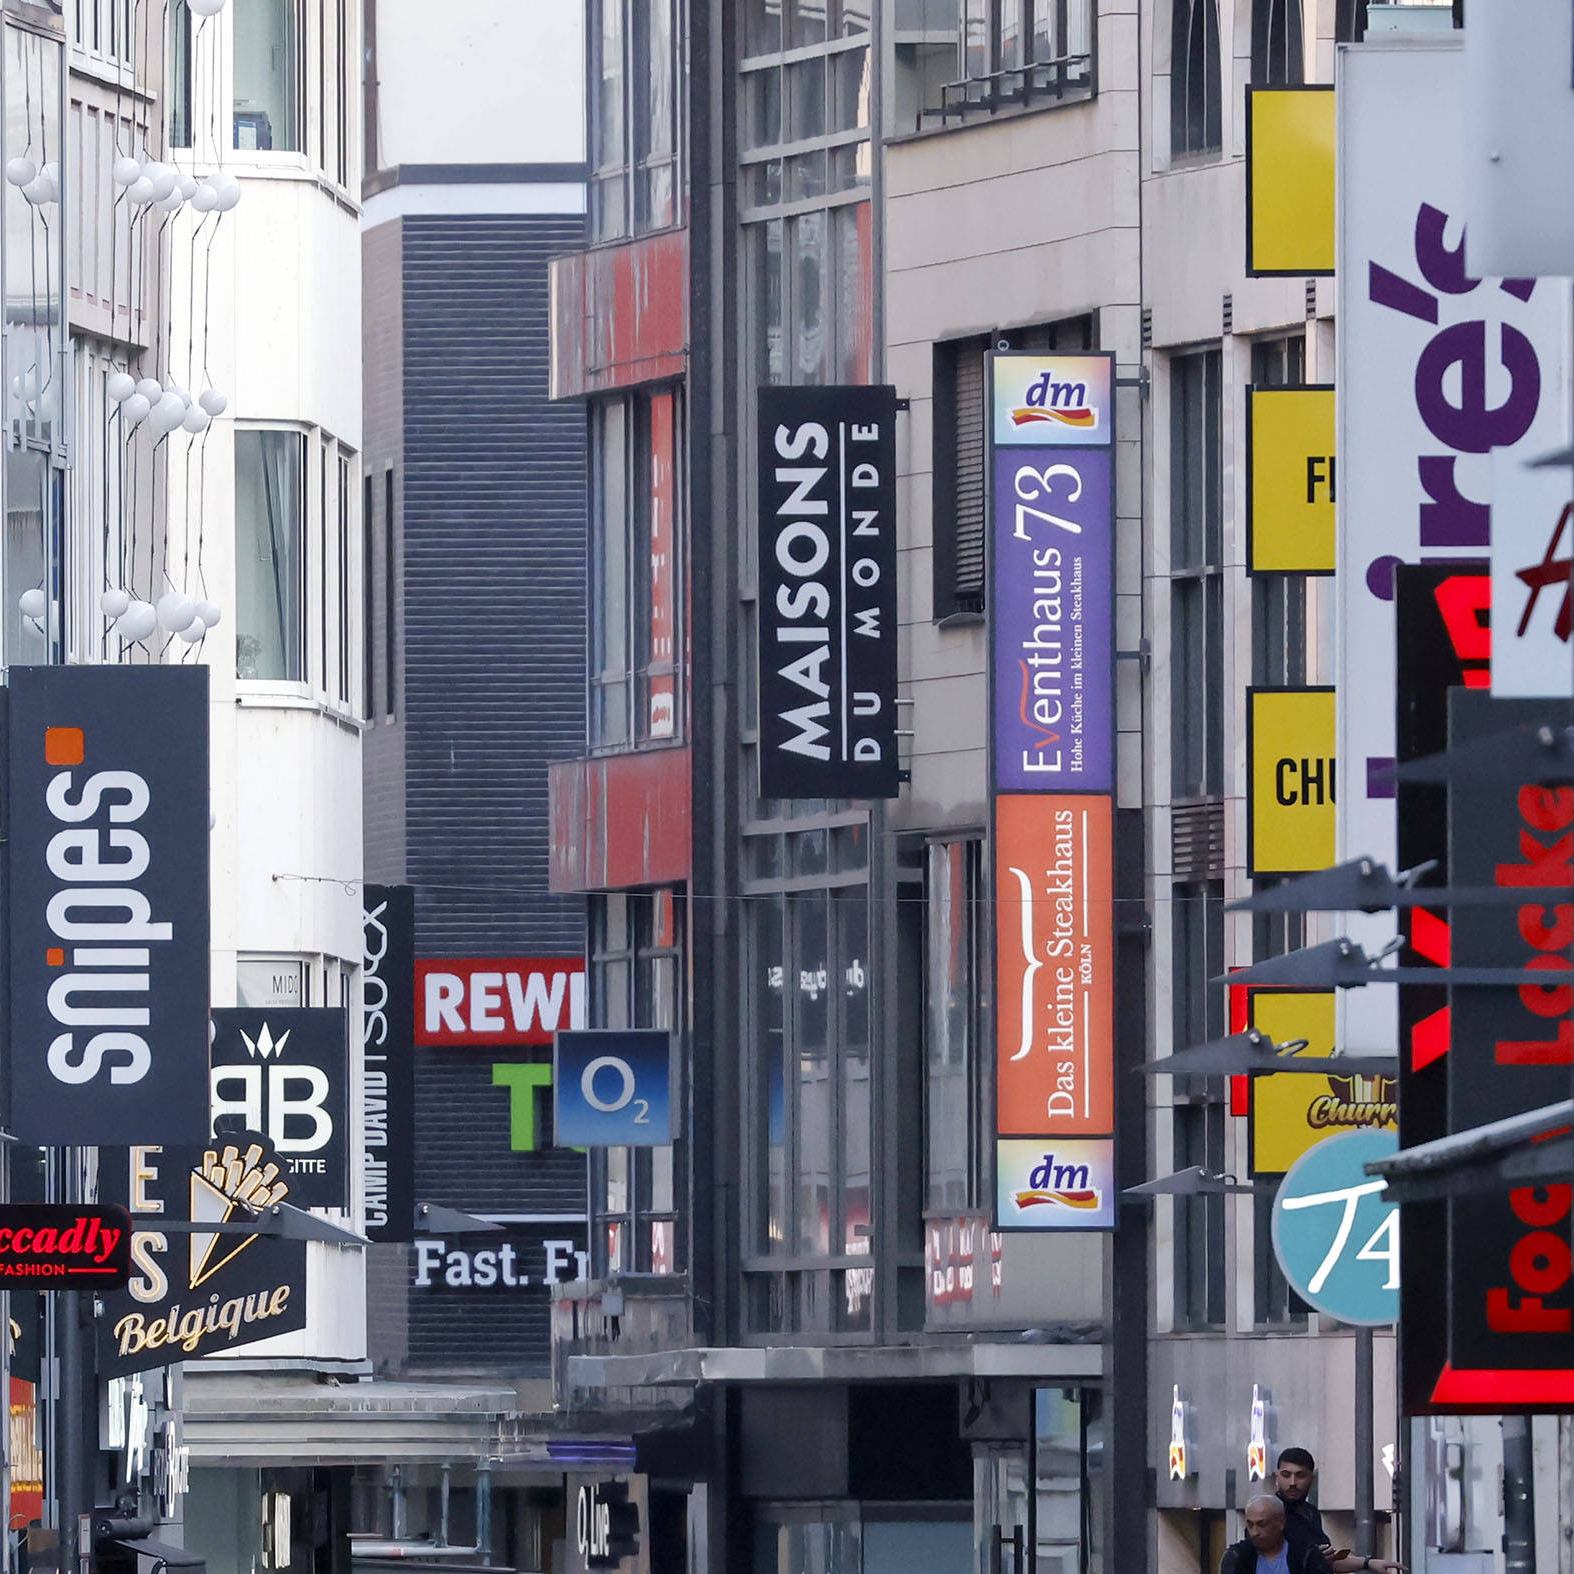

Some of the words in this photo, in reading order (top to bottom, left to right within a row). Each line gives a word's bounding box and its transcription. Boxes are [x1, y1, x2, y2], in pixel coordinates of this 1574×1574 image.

[1026, 372, 1087, 407] dm
[852, 422, 881, 639] MONDE
[1013, 463, 1082, 541] 73
[775, 421, 830, 761] MAISONS
[1070, 556, 1083, 621] Steakhaus
[1019, 547, 1063, 773] Eventhaus
[1071, 624, 1083, 669] kleinen
[1069, 693, 1083, 734] Küche
[1071, 672, 1083, 690] im
[853, 692, 882, 762] DU
[1070, 738, 1083, 772] Hohe
[1047, 810, 1075, 957] Steakhaus
[45, 770, 173, 1085] snipes
[1079, 943, 1093, 985] KÖLN
[1047, 967, 1075, 1053] kleine
[492, 1062, 552, 1152] T
[1047, 1062, 1075, 1119] Das
[1307, 1095, 1399, 1130] Churr
[1029, 1154, 1089, 1190] dm
[415, 1240, 529, 1287] Fast.
[113, 1284, 291, 1358] Belgique
